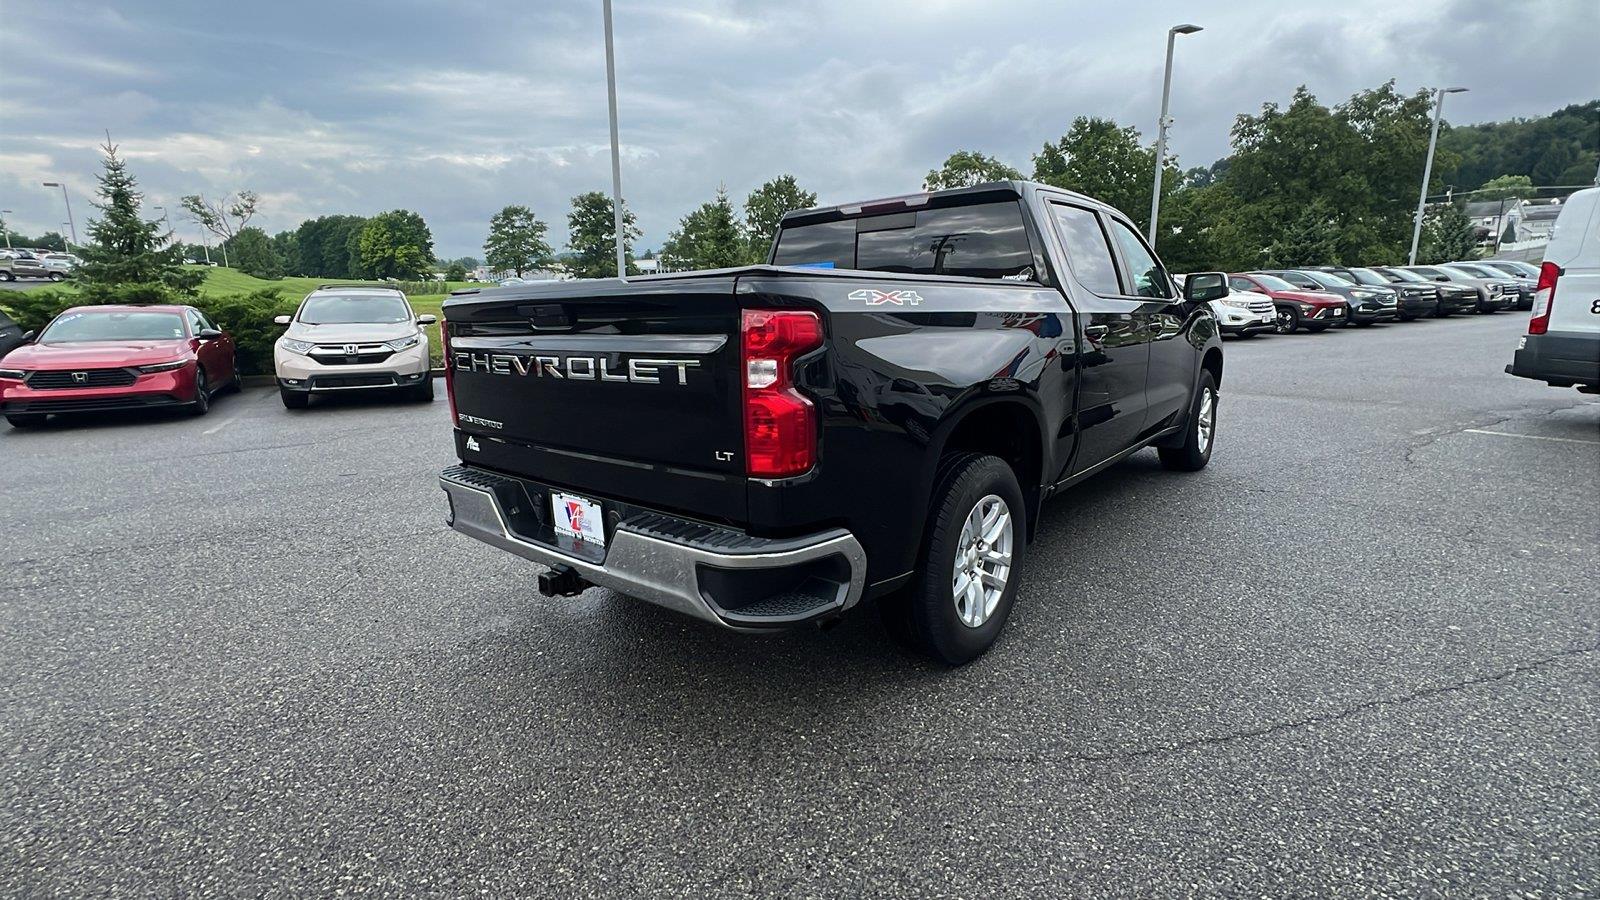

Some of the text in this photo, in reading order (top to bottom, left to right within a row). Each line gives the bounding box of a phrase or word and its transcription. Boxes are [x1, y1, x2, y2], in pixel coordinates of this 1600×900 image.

[455, 352, 700, 386] CHEVROLET
[458, 412, 503, 429] SILVERADO
[715, 451, 735, 461] LT
